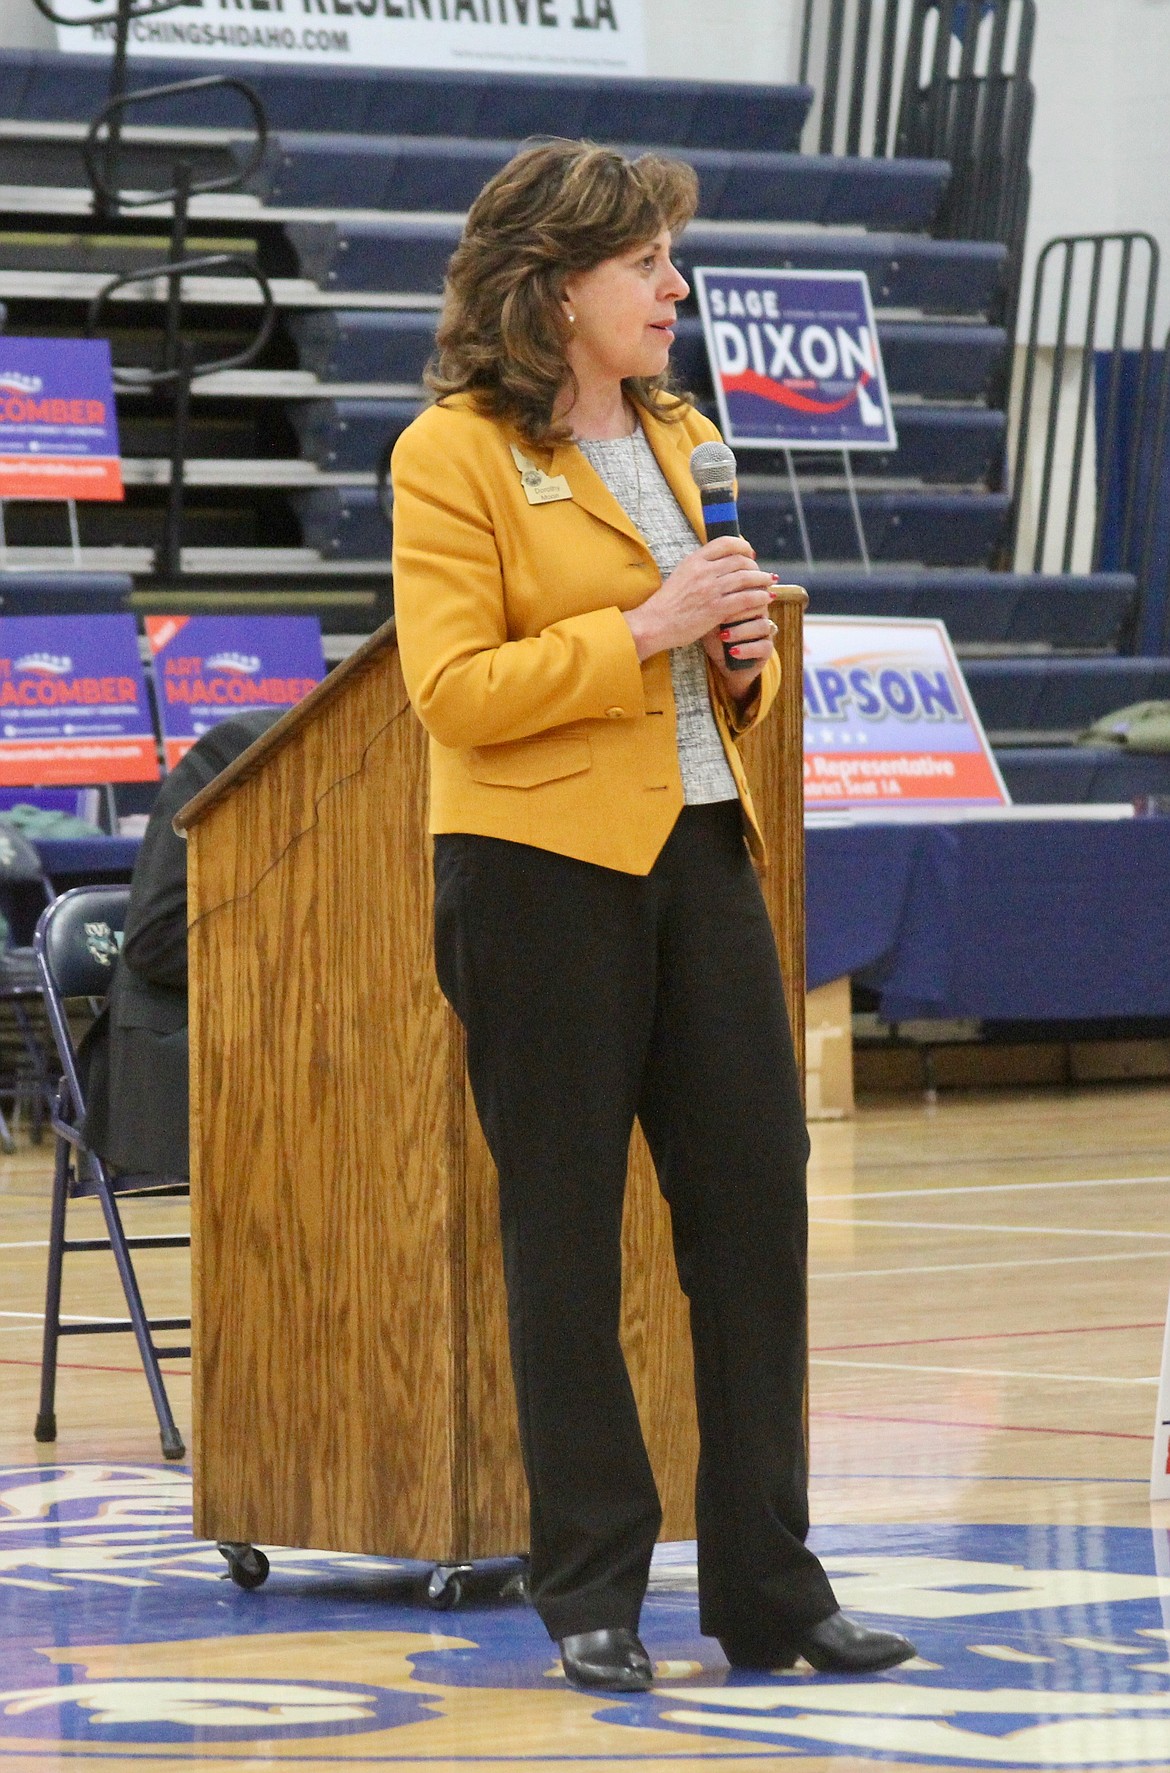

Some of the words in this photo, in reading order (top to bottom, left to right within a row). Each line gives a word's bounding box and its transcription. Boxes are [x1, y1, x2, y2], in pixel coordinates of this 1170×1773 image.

[709, 289, 779, 319] SAGE
[713, 321, 876, 380] DIXON
[165, 658, 203, 675] ART
[813, 756, 955, 783] Representative
